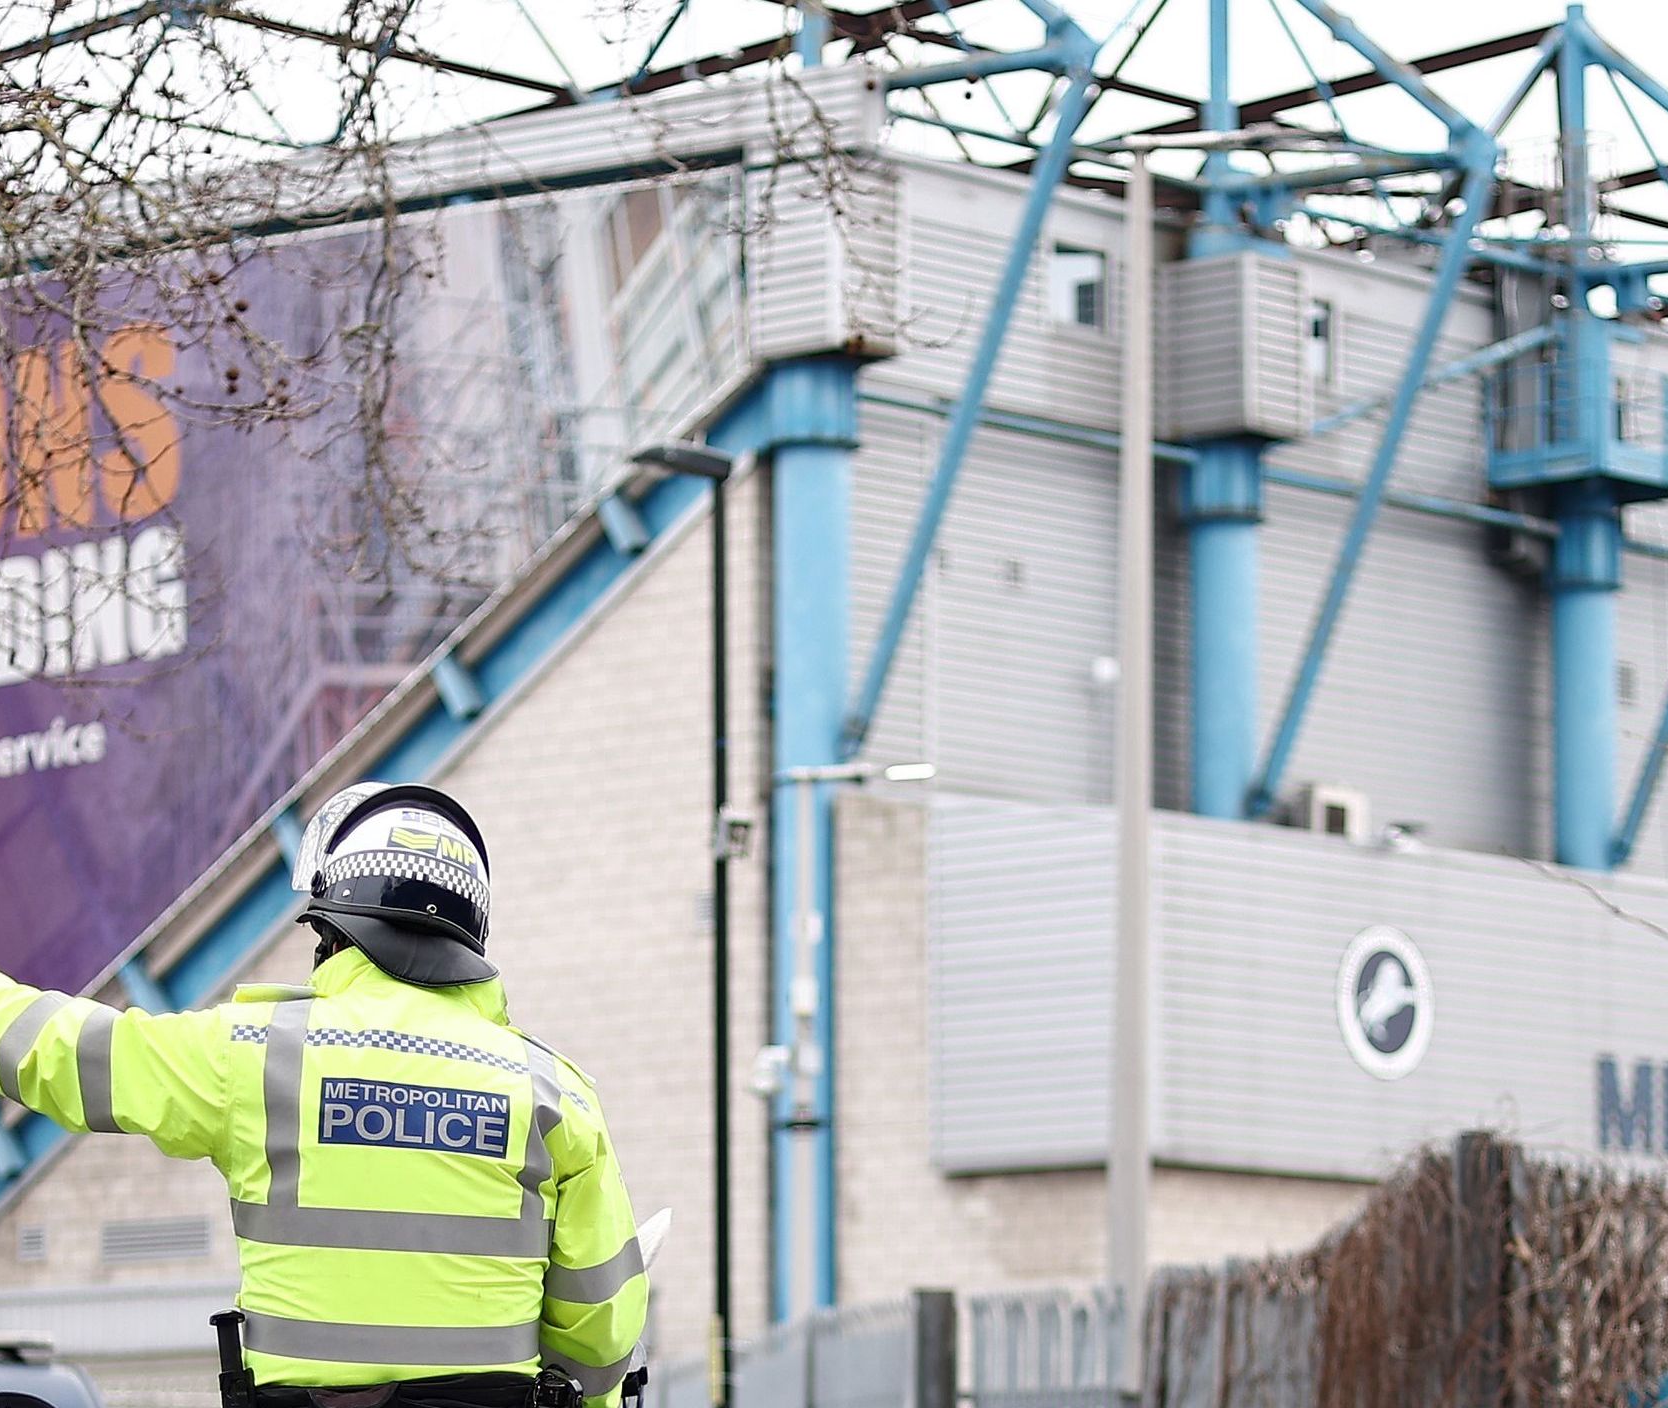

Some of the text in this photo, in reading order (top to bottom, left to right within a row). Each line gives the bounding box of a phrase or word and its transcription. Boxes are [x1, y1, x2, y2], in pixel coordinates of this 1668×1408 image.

[439, 835, 478, 868] MP
[324, 1082, 508, 1114] METROPOLITAN
[322, 1103, 507, 1153] POLICE
